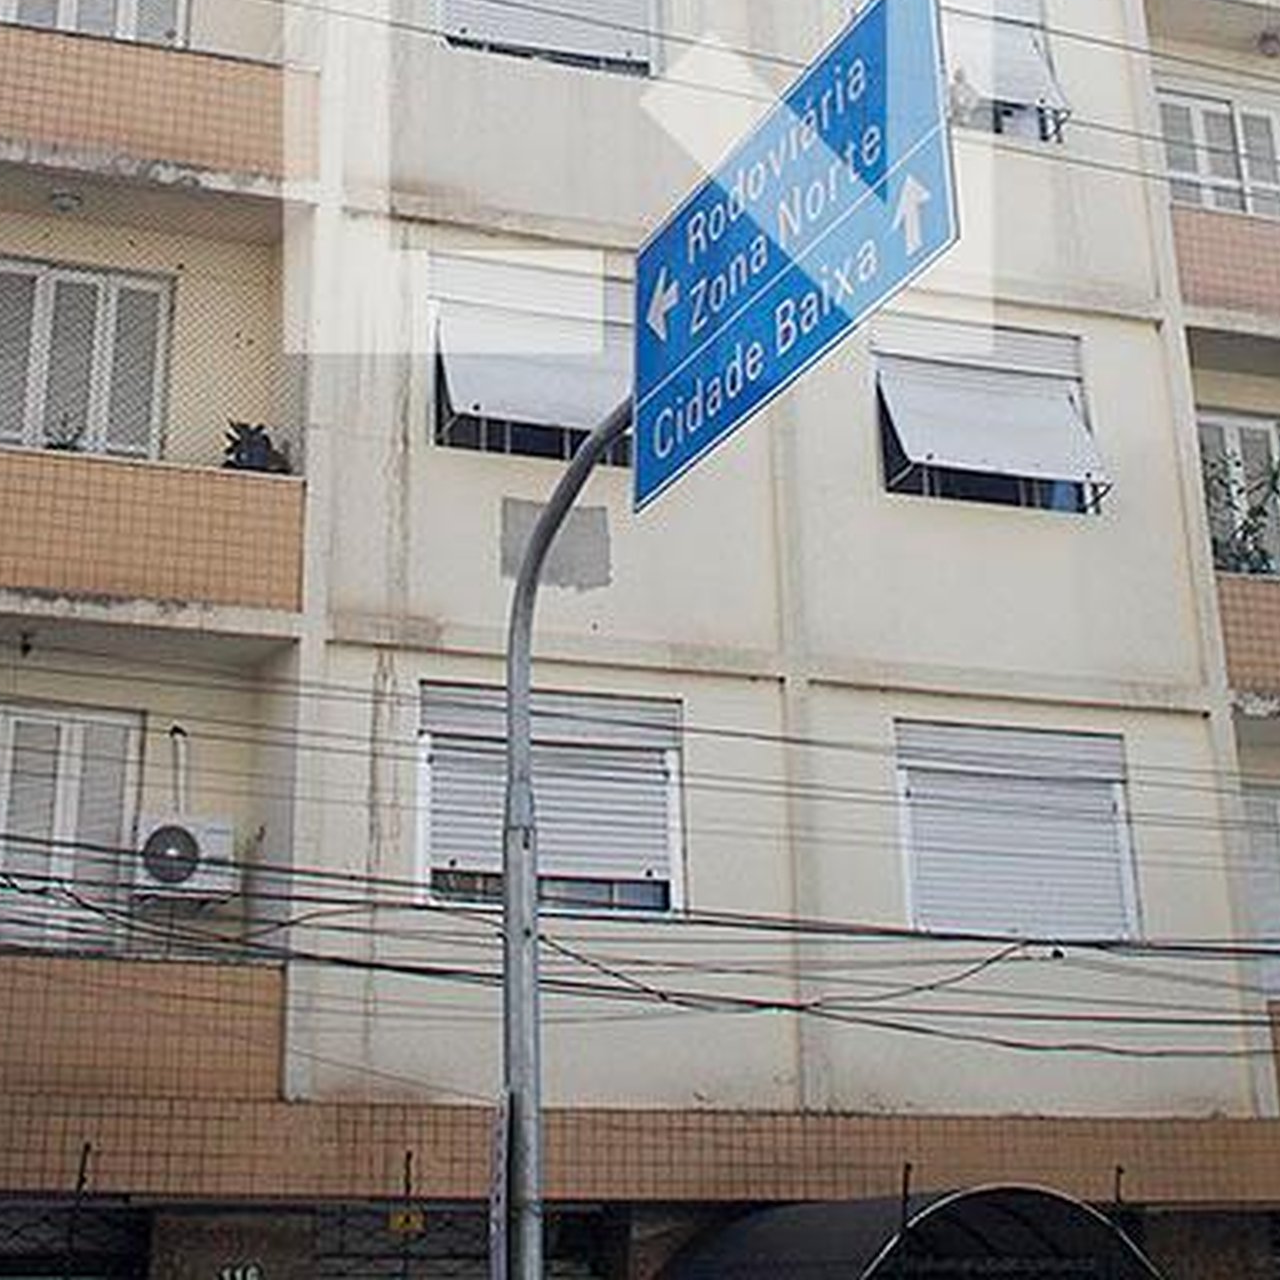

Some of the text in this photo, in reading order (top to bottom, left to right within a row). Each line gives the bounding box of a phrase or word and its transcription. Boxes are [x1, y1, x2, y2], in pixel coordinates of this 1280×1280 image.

[686, 56, 868, 264] Rodoviária
[688, 124, 881, 336] Zona Norte
[652, 237, 879, 460] Cidade Baixa
